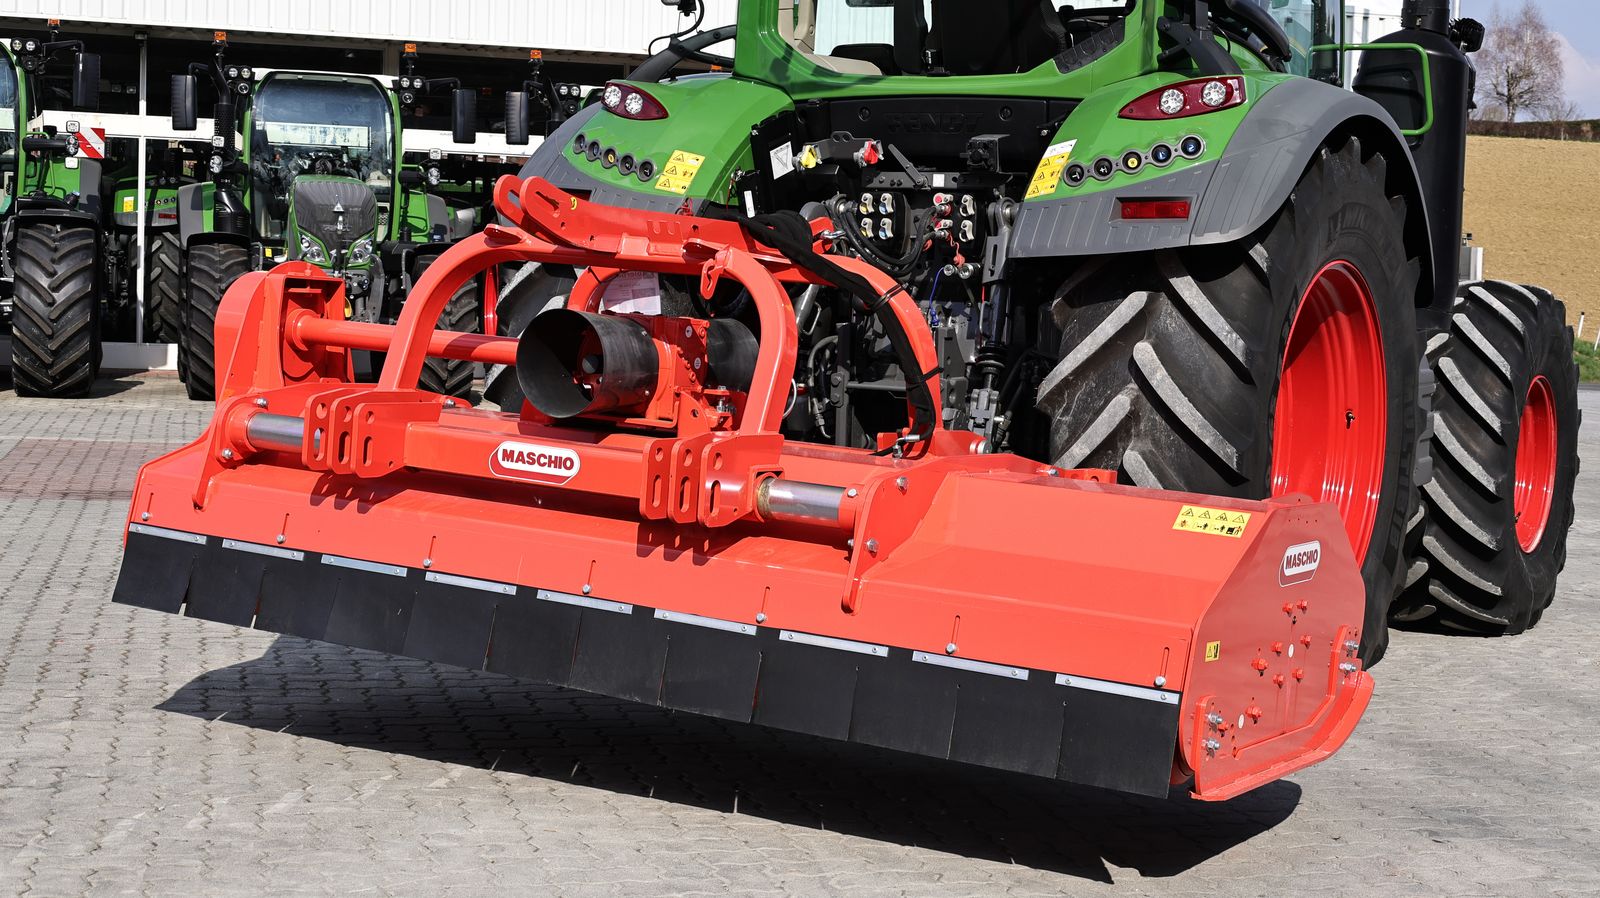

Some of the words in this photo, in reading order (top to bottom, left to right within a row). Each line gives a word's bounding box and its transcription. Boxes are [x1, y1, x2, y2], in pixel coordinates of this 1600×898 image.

[884, 112, 984, 134] FENDT
[501, 449, 574, 471] MASCHIO
[1285, 549, 1318, 570] MASCHIO
